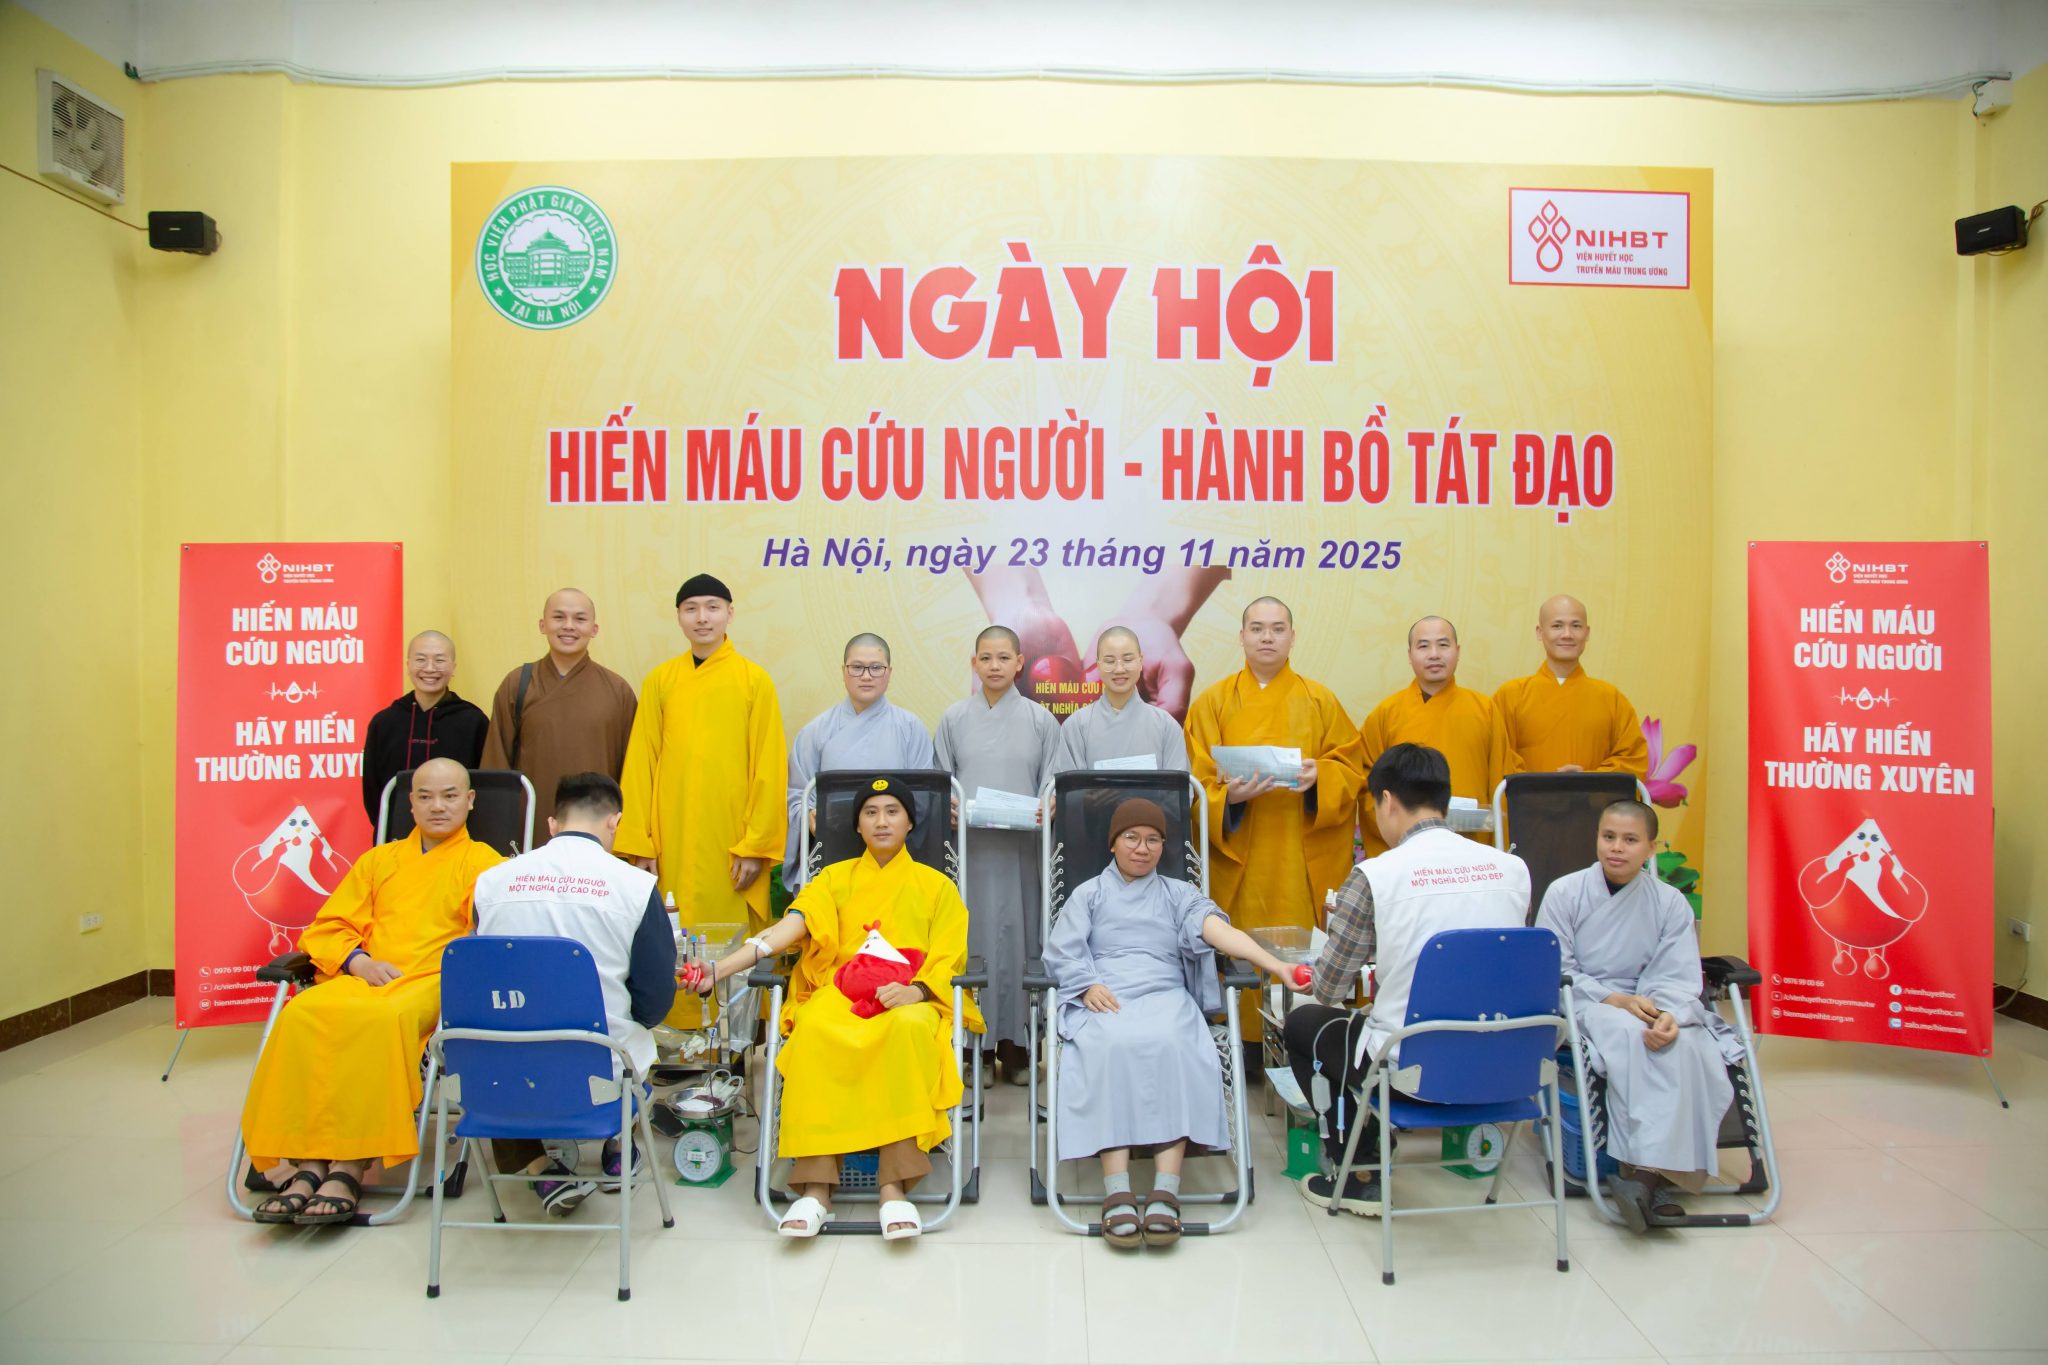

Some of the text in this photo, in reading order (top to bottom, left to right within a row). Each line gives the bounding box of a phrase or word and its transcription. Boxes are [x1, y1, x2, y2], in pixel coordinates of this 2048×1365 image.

[485, 216, 511, 247] VIỆN
[1576, 230, 1668, 249] NIHBT
[484, 252, 500, 282] HỌC
[594, 247, 609, 280] NAM
[1576, 251, 1634, 263] VIỆN HUYẾT HỌC
[1576, 263, 1603, 274] TRUYỀN
[1605, 265, 1622, 275] MÁU
[1624, 267, 1647, 275] TRUNG
[510, 299, 583, 322] TẠI HÀ NỘI
[834, 243, 1334, 387] NGÀY HỘI
[549, 405, 1613, 524] HIẾN MÁU CỨU NGƯỜI - HÀNH BỒ TÁT ĐẠO
[283, 563, 335, 573] NIHBT
[763, 537, 1401, 574] Hà Nội, ngày 23 tháng 11 năm 2025
[1852, 563, 1909, 573] NIHBT
[232, 600, 358, 632] HIẾN MÁU
[1800, 600, 1935, 635] HIẾN MÁU
[225, 634, 364, 666] CỨU NGƯỜI
[1794, 637, 1942, 671] CỨU NGƯỜI
[1036, 679, 1057, 694] HIẾN
[1059, 680, 1079, 694] MÁU
[235, 711, 355, 747] HÃY HIẾN
[1803, 721, 1931, 757] HÃY HIẾN
[195, 749, 364, 782] THƯỜNG XUY
[1764, 757, 1974, 796] THƯỜNG XUYÊN
[508, 883, 527, 893] MỘT
[570, 886, 589, 894] CAO
[538, 874, 557, 883] MÁU
[1411, 878, 1429, 888] MỘT
[1471, 873, 1488, 882] CAO
[491, 990, 526, 1009] LD
